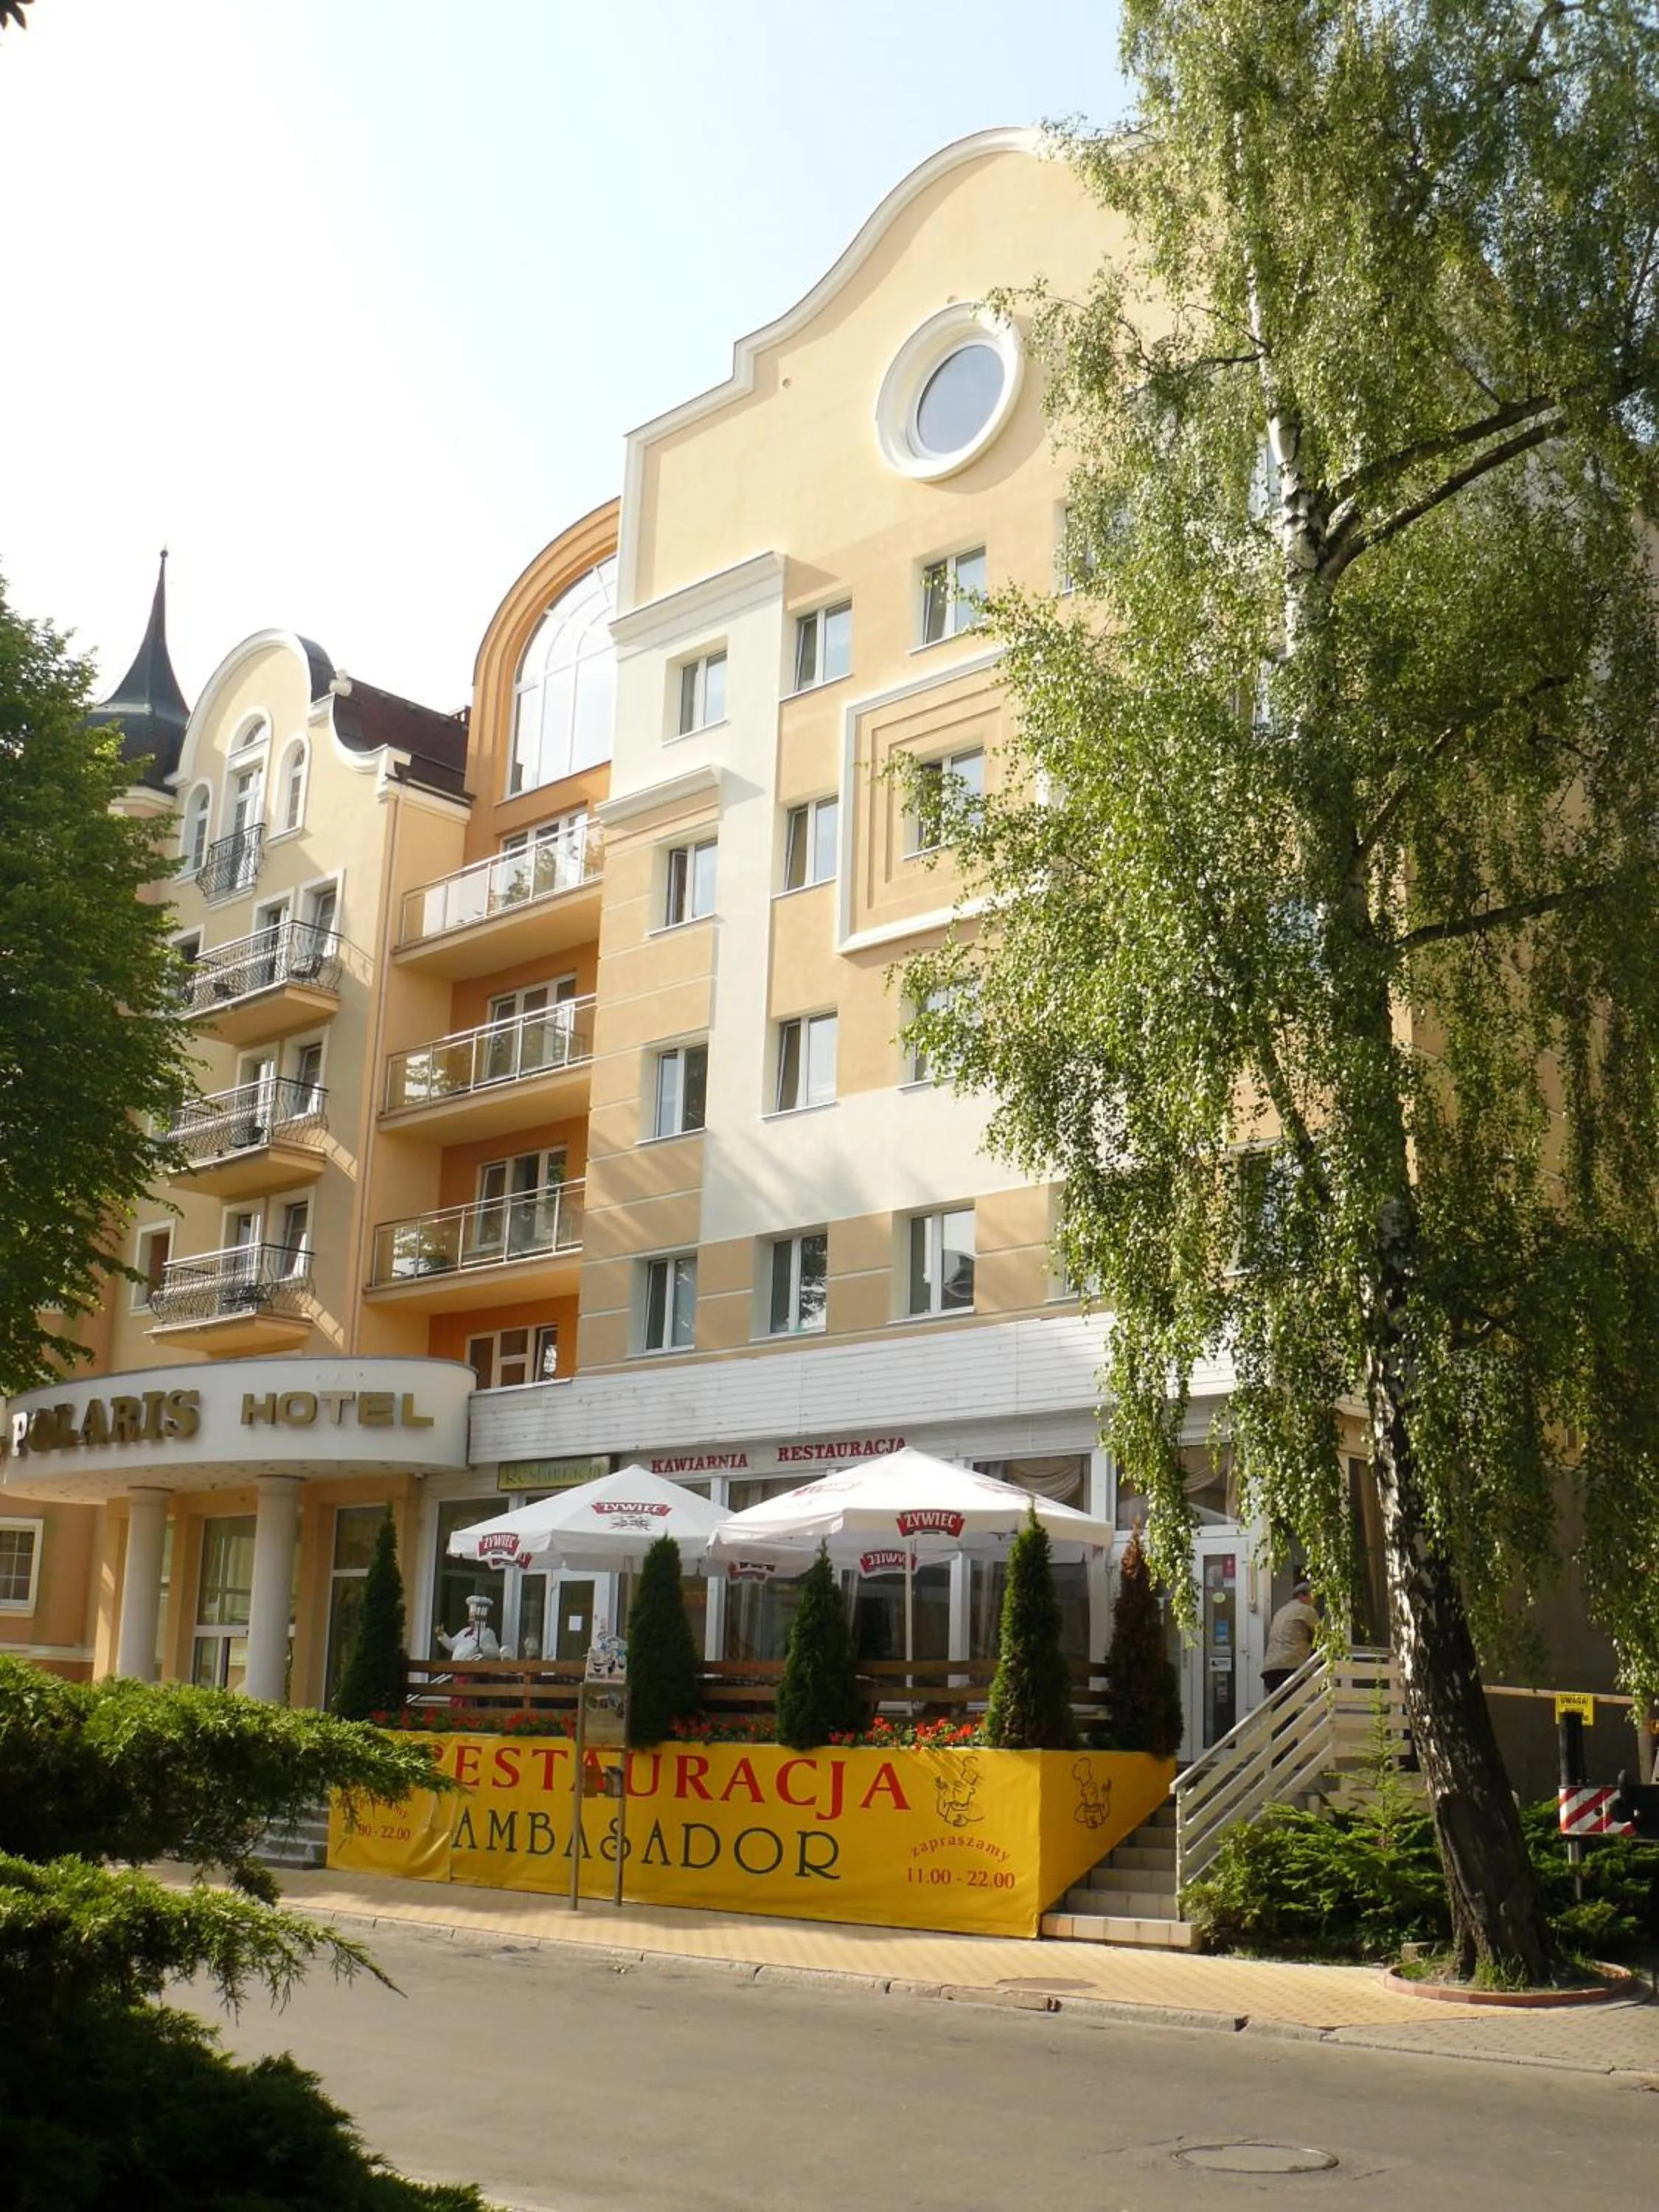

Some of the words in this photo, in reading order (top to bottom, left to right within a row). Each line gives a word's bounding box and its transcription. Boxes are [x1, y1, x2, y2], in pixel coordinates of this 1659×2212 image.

[12, 1389, 201, 1457] POLARIS
[240, 1391, 434, 1427] HOTEL
[652, 1453, 748, 1473] KAWIARNIA
[778, 1437, 906, 1462] RESTAURACJA
[434, 1744, 911, 1821] ESTAURACJA
[451, 1806, 841, 1879] AMBASADOR
[911, 1835, 1011, 1863] zapraszamy
[907, 1867, 952, 1885] 11.00
[967, 1869, 1015, 1889] 22.00
